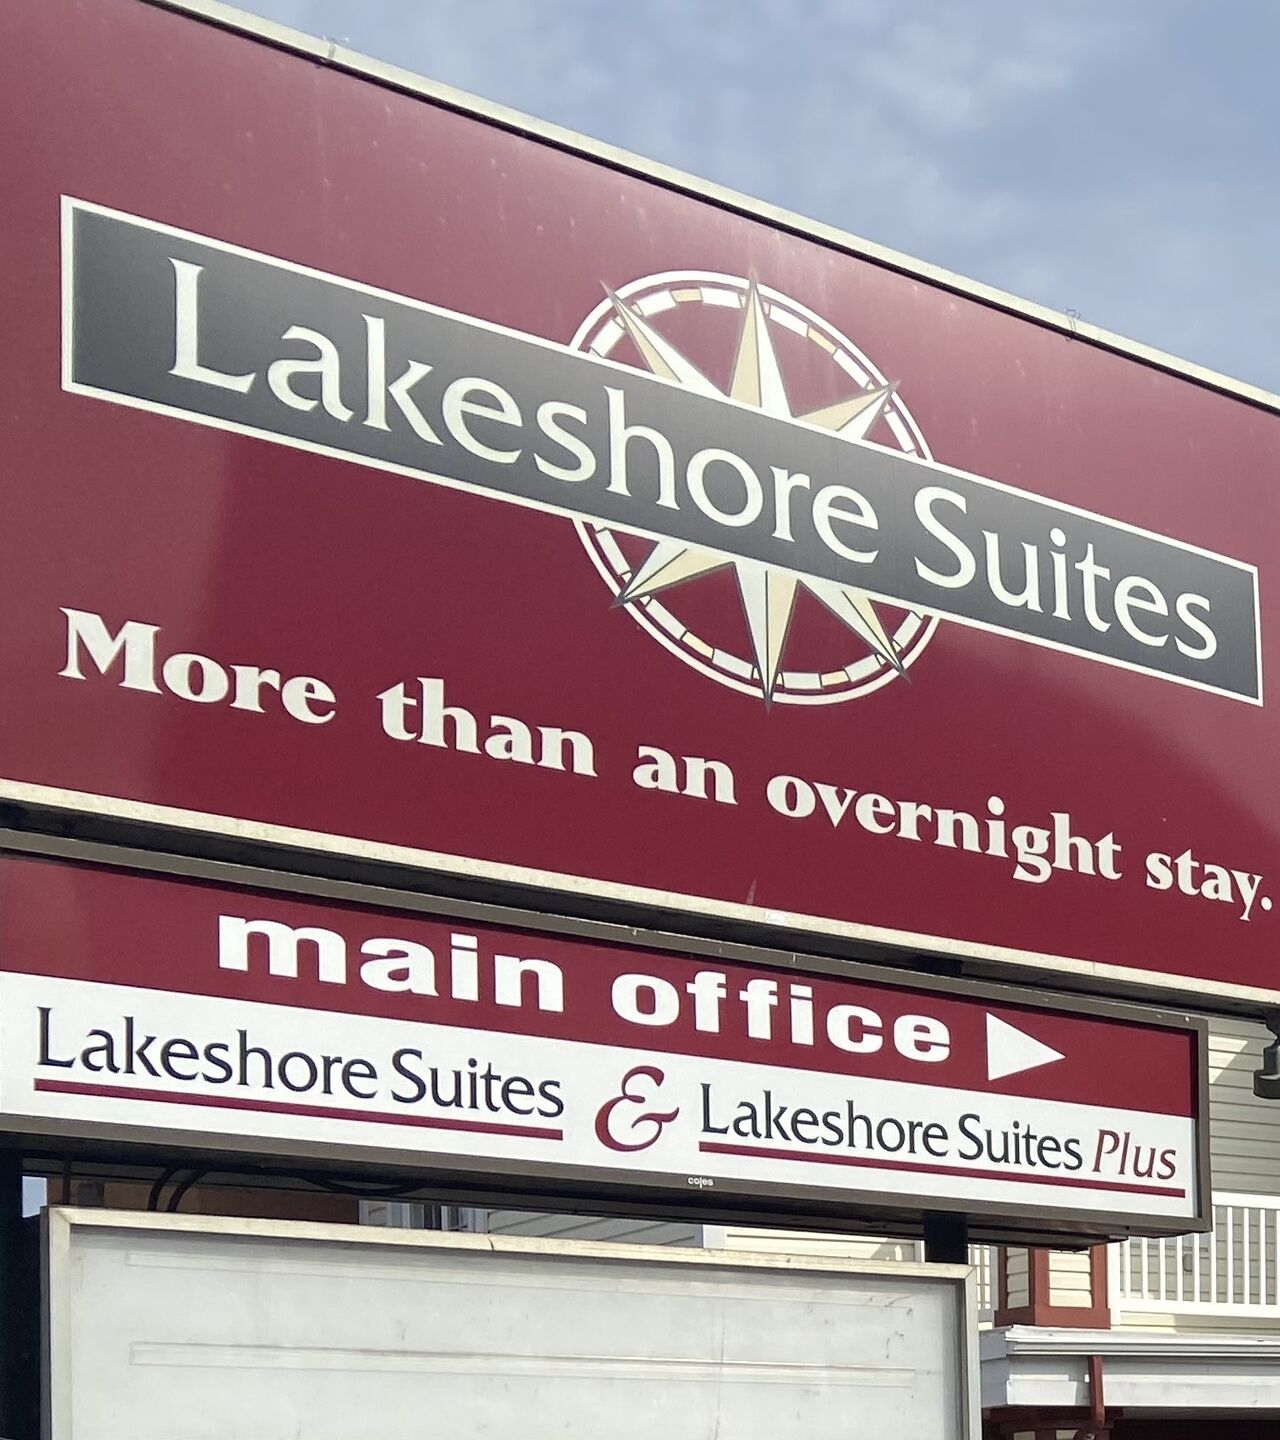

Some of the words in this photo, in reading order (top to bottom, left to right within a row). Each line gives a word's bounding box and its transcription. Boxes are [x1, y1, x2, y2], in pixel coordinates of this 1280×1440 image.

[168, 257, 880, 564] Lakeshore
[915, 487, 1216, 660] Suites
[59, 608, 336, 724] More
[377, 683, 597, 777] than
[633, 746, 738, 804] an
[767, 776, 1122, 883] overnight
[1146, 849, 1274, 921] stay.
[37, 1006, 378, 1099] Lakeshore
[391, 1049, 564, 1118] Suites
[594, 1065, 680, 1153] &
[701, 1083, 950, 1157] Lakeshore
[958, 1114, 1083, 1171] Suites
[1093, 1130, 1178, 1181] Plus
[219, 916, 564, 1013] main
[611, 972, 950, 1063] office
